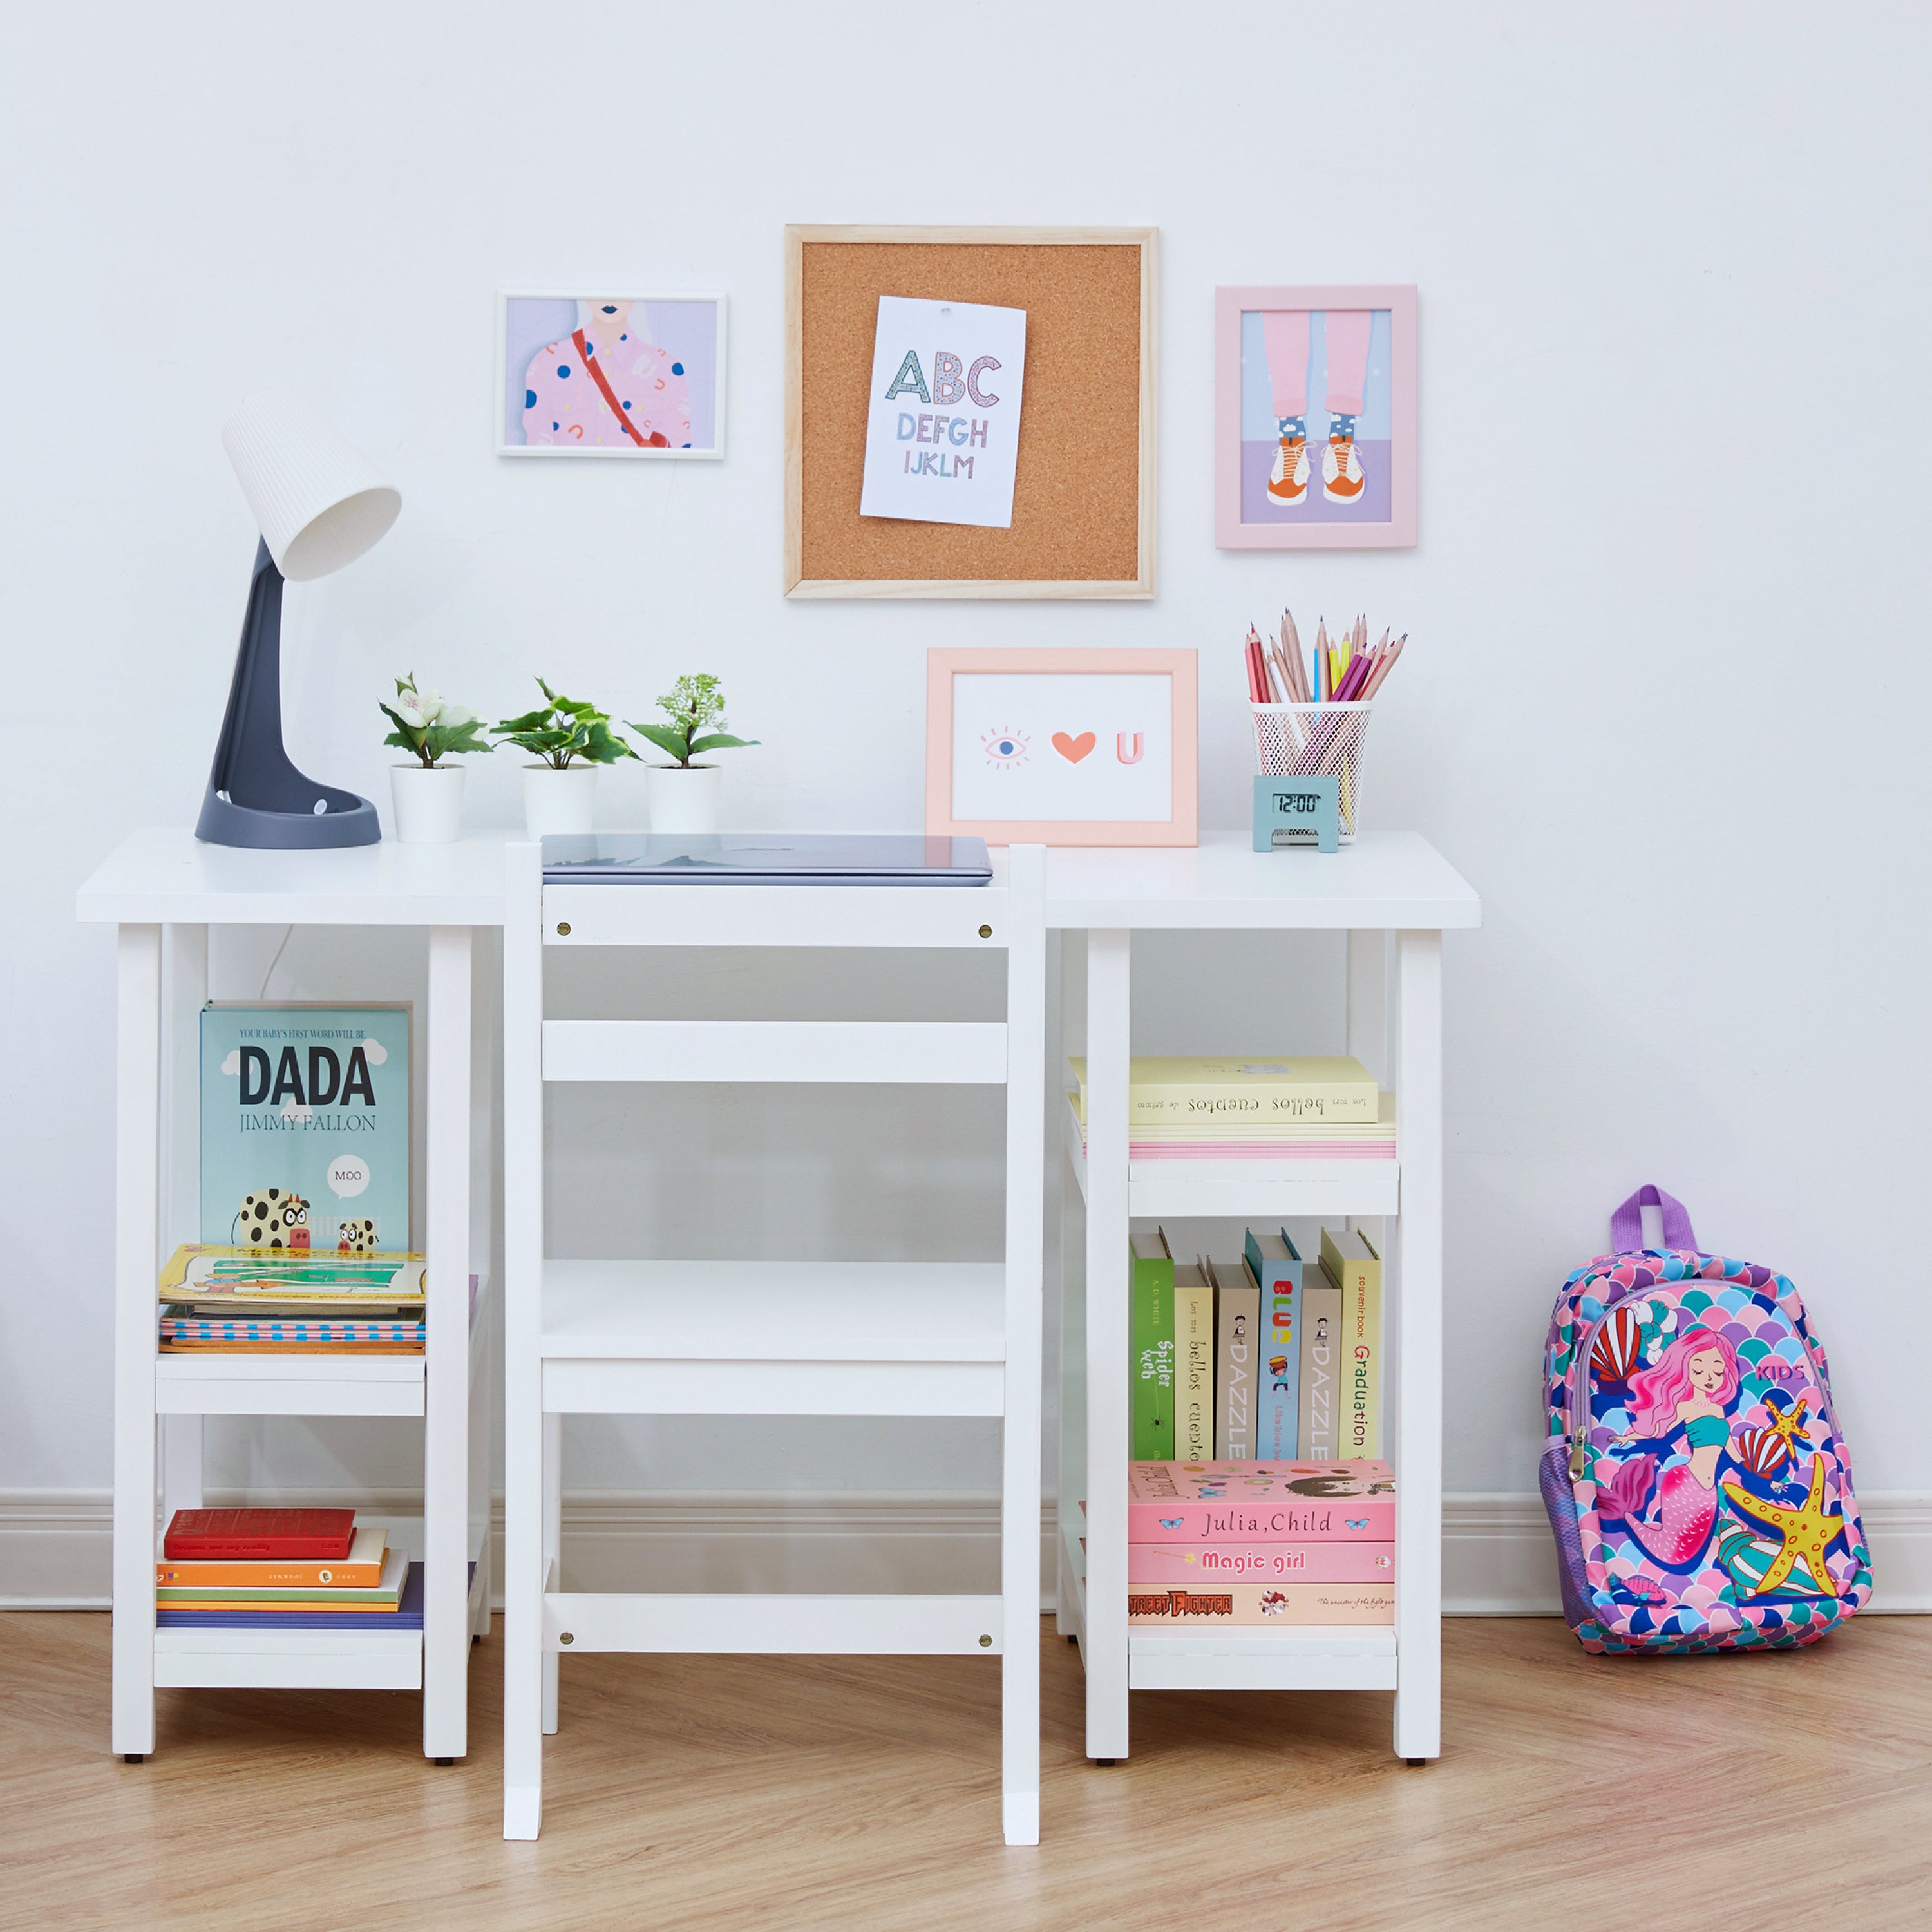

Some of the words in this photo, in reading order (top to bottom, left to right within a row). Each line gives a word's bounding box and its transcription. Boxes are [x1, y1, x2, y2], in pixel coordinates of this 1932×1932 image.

[885, 350, 1001, 408] ABC
[896, 413, 989, 448] DEFGH
[904, 450, 974, 479] IJKLM
[1117, 732, 1144, 764] U
[1279, 795, 1316, 813] 12:00
[240, 1029, 261, 1038] YOUR
[262, 1030, 287, 1039] BABY'S
[289, 1030, 308, 1039] FIRST
[310, 1030, 334, 1039] WORD
[336, 1030, 354, 1039] WILL
[355, 1030, 365, 1039] BE
[239, 1046, 376, 1106] DADA
[1188, 1099, 1259, 1113] cuentos
[1272, 1097, 1324, 1115] bellos
[240, 1114, 298, 1133] JIMMY
[303, 1114, 376, 1132] FALLON
[336, 1171, 362, 1180] MOO
[1358, 1276, 1366, 1314] souvenir
[1356, 1316, 1365, 1338] book
[1140, 1350, 1157, 1379] web
[1151, 1340, 1173, 1387] Spider
[1189, 1341, 1206, 1390] bellos
[1228, 1345, 1248, 1460] DAZZLE
[1310, 1347, 1330, 1460] DAZZLE
[1353, 1345, 1370, 1446] Graduation
[1202, 1552, 1265, 1574] Magic
[1273, 1552, 1305, 1574] girl
[1128, 1595, 1171, 1616] TREET
[1167, 1591, 1233, 1617] FIGHTER
